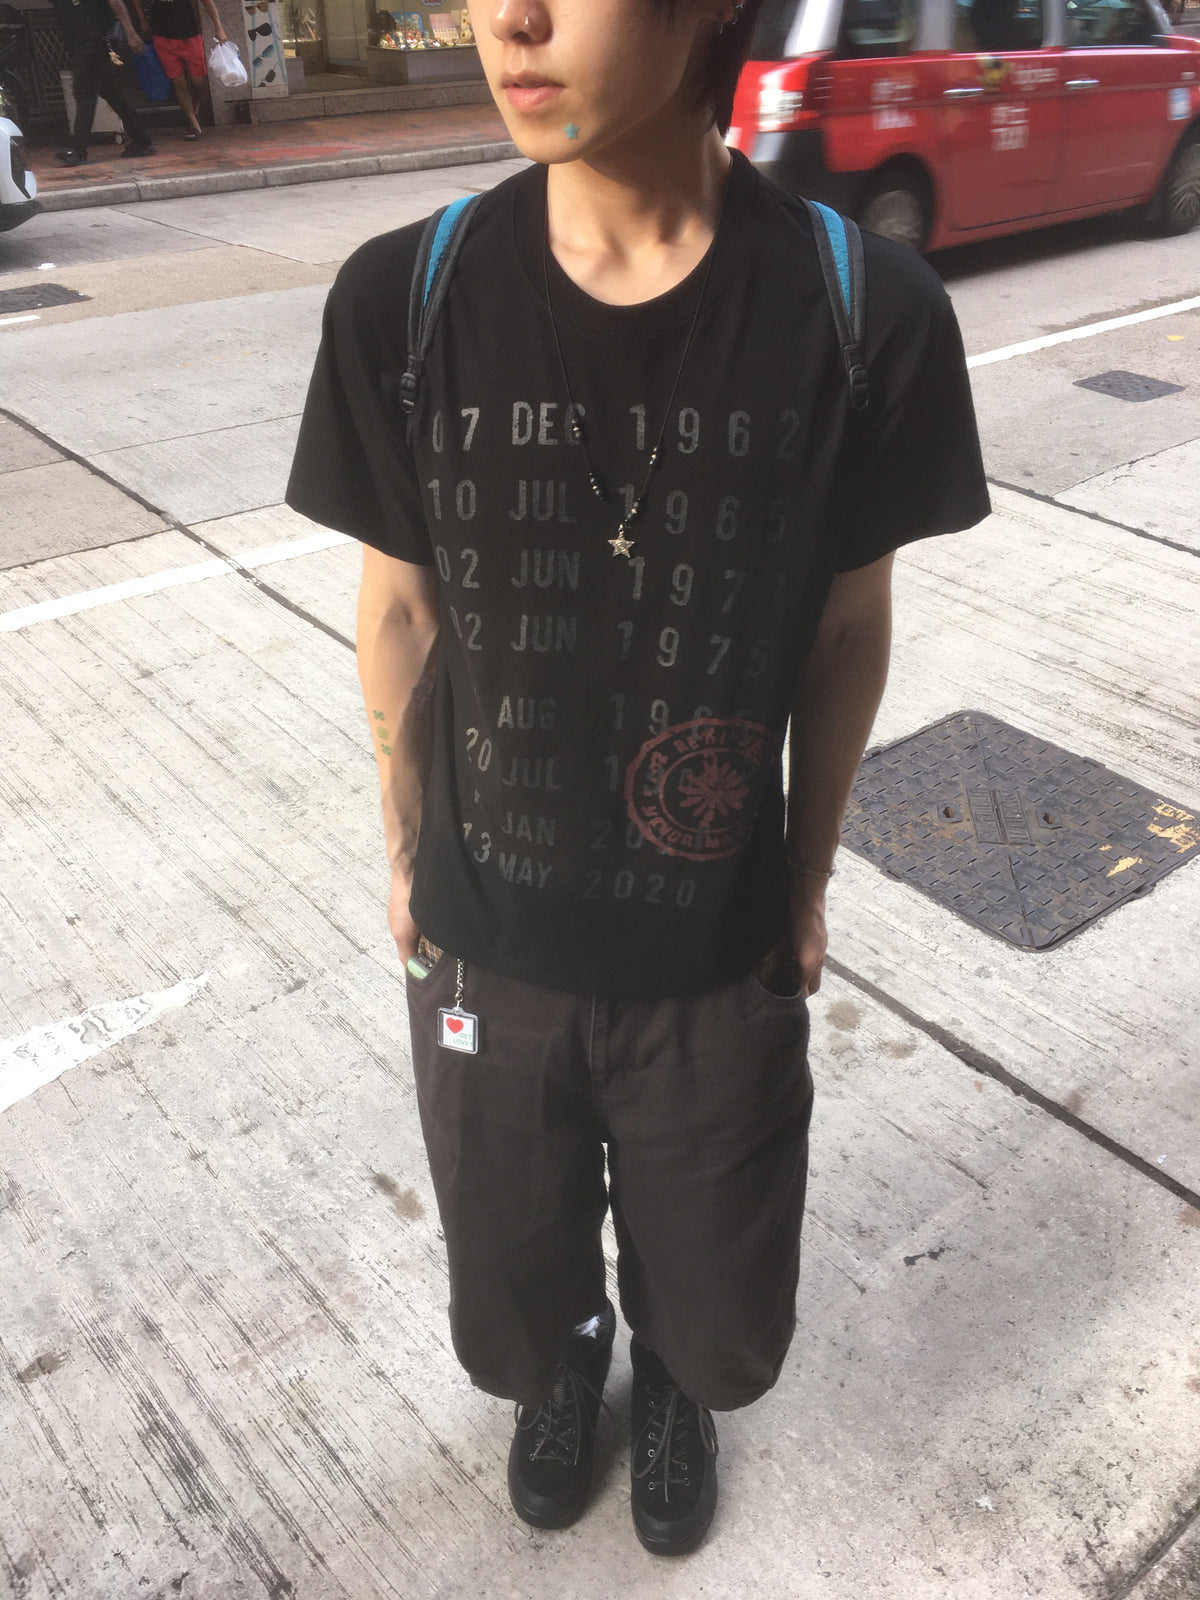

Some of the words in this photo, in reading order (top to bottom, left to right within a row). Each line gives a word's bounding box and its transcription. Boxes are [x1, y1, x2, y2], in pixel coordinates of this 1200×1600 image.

[432, 407, 480, 452] 07
[511, 401, 586, 446] DEC
[629, 403, 800, 458] 1962
[427, 478, 477, 520] 10
[508, 479, 577, 523] JUL
[435, 545, 480, 589] 02
[511, 548, 580, 591] JUN
[511, 614, 577, 652] JUN
[497, 696, 557, 730] AUG
[502, 757, 562, 790] JUL
[501, 811, 556, 846] JAN
[499, 852, 553, 889] MAY
[581, 869, 696, 908] 2020
